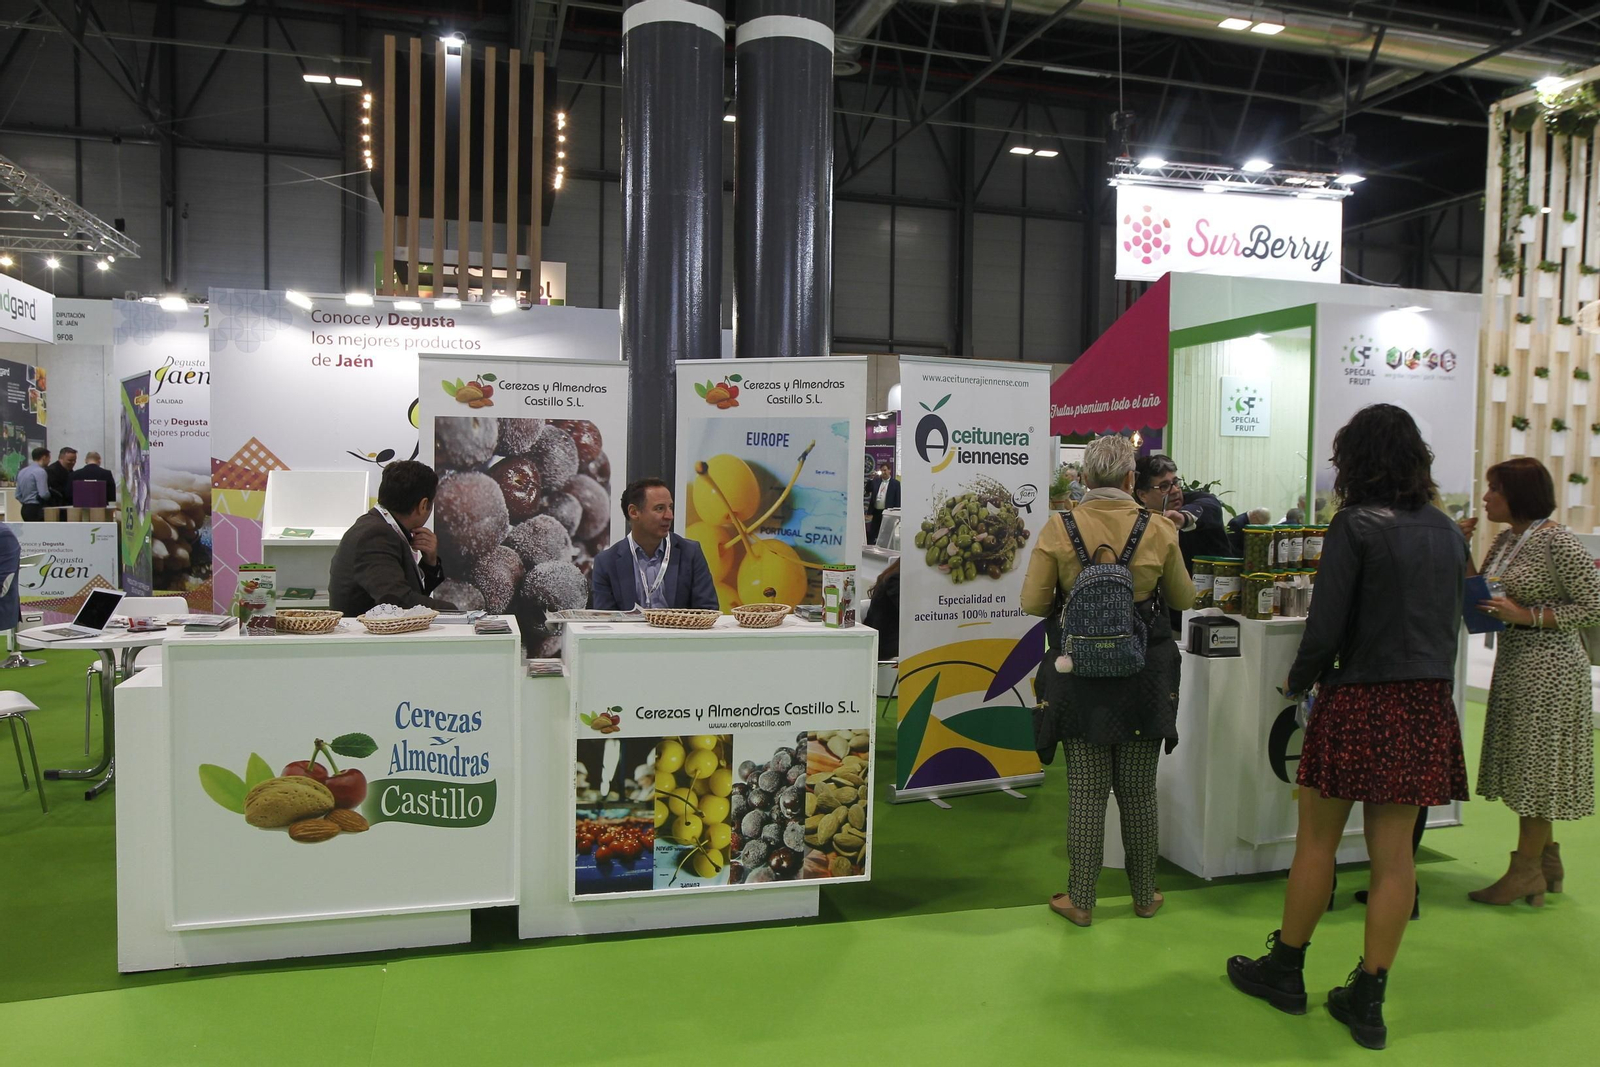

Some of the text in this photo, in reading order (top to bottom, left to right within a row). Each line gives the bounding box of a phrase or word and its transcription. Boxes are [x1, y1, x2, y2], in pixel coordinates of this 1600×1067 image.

[1187, 218, 1332, 272] SurBerry
[0, 288, 36, 321] dgard
[311, 309, 455, 330] Conoce y Degusta
[311, 331, 481, 350] los mejores productos
[163, 355, 206, 368] Degusta
[312, 353, 373, 367] de Jaén
[1344, 368, 1376, 377] SPECIAL
[499, 380, 607, 394] Cerezas y Almendras
[743, 379, 845, 391] Cerezas y Almendras
[922, 373, 1029, 387] www.aceitunerajiennense.com
[1349, 377, 1371, 385] FRUIT
[524, 396, 584, 408] Castillo S.L.
[766, 394, 823, 404] Castillo S.L.
[1050, 393, 1161, 419] Frutas premium todo el año
[171, 418, 208, 427] Degusta
[180, 429, 210, 437] produc
[747, 432, 789, 448] EUROPE
[760, 527, 802, 538] PORTUGAL
[805, 532, 843, 545] SPAIN
[47, 555, 83, 564] Degusta
[939, 594, 1006, 606] Especialidad en
[914, 608, 1029, 622] aceitunas 100% naturale
[395, 701, 483, 734] Cerezas
[635, 700, 860, 722] Cerezas y Almendras Castillo S.L.
[388, 739, 489, 776] Almendras
[381, 785, 483, 820] Castillo
